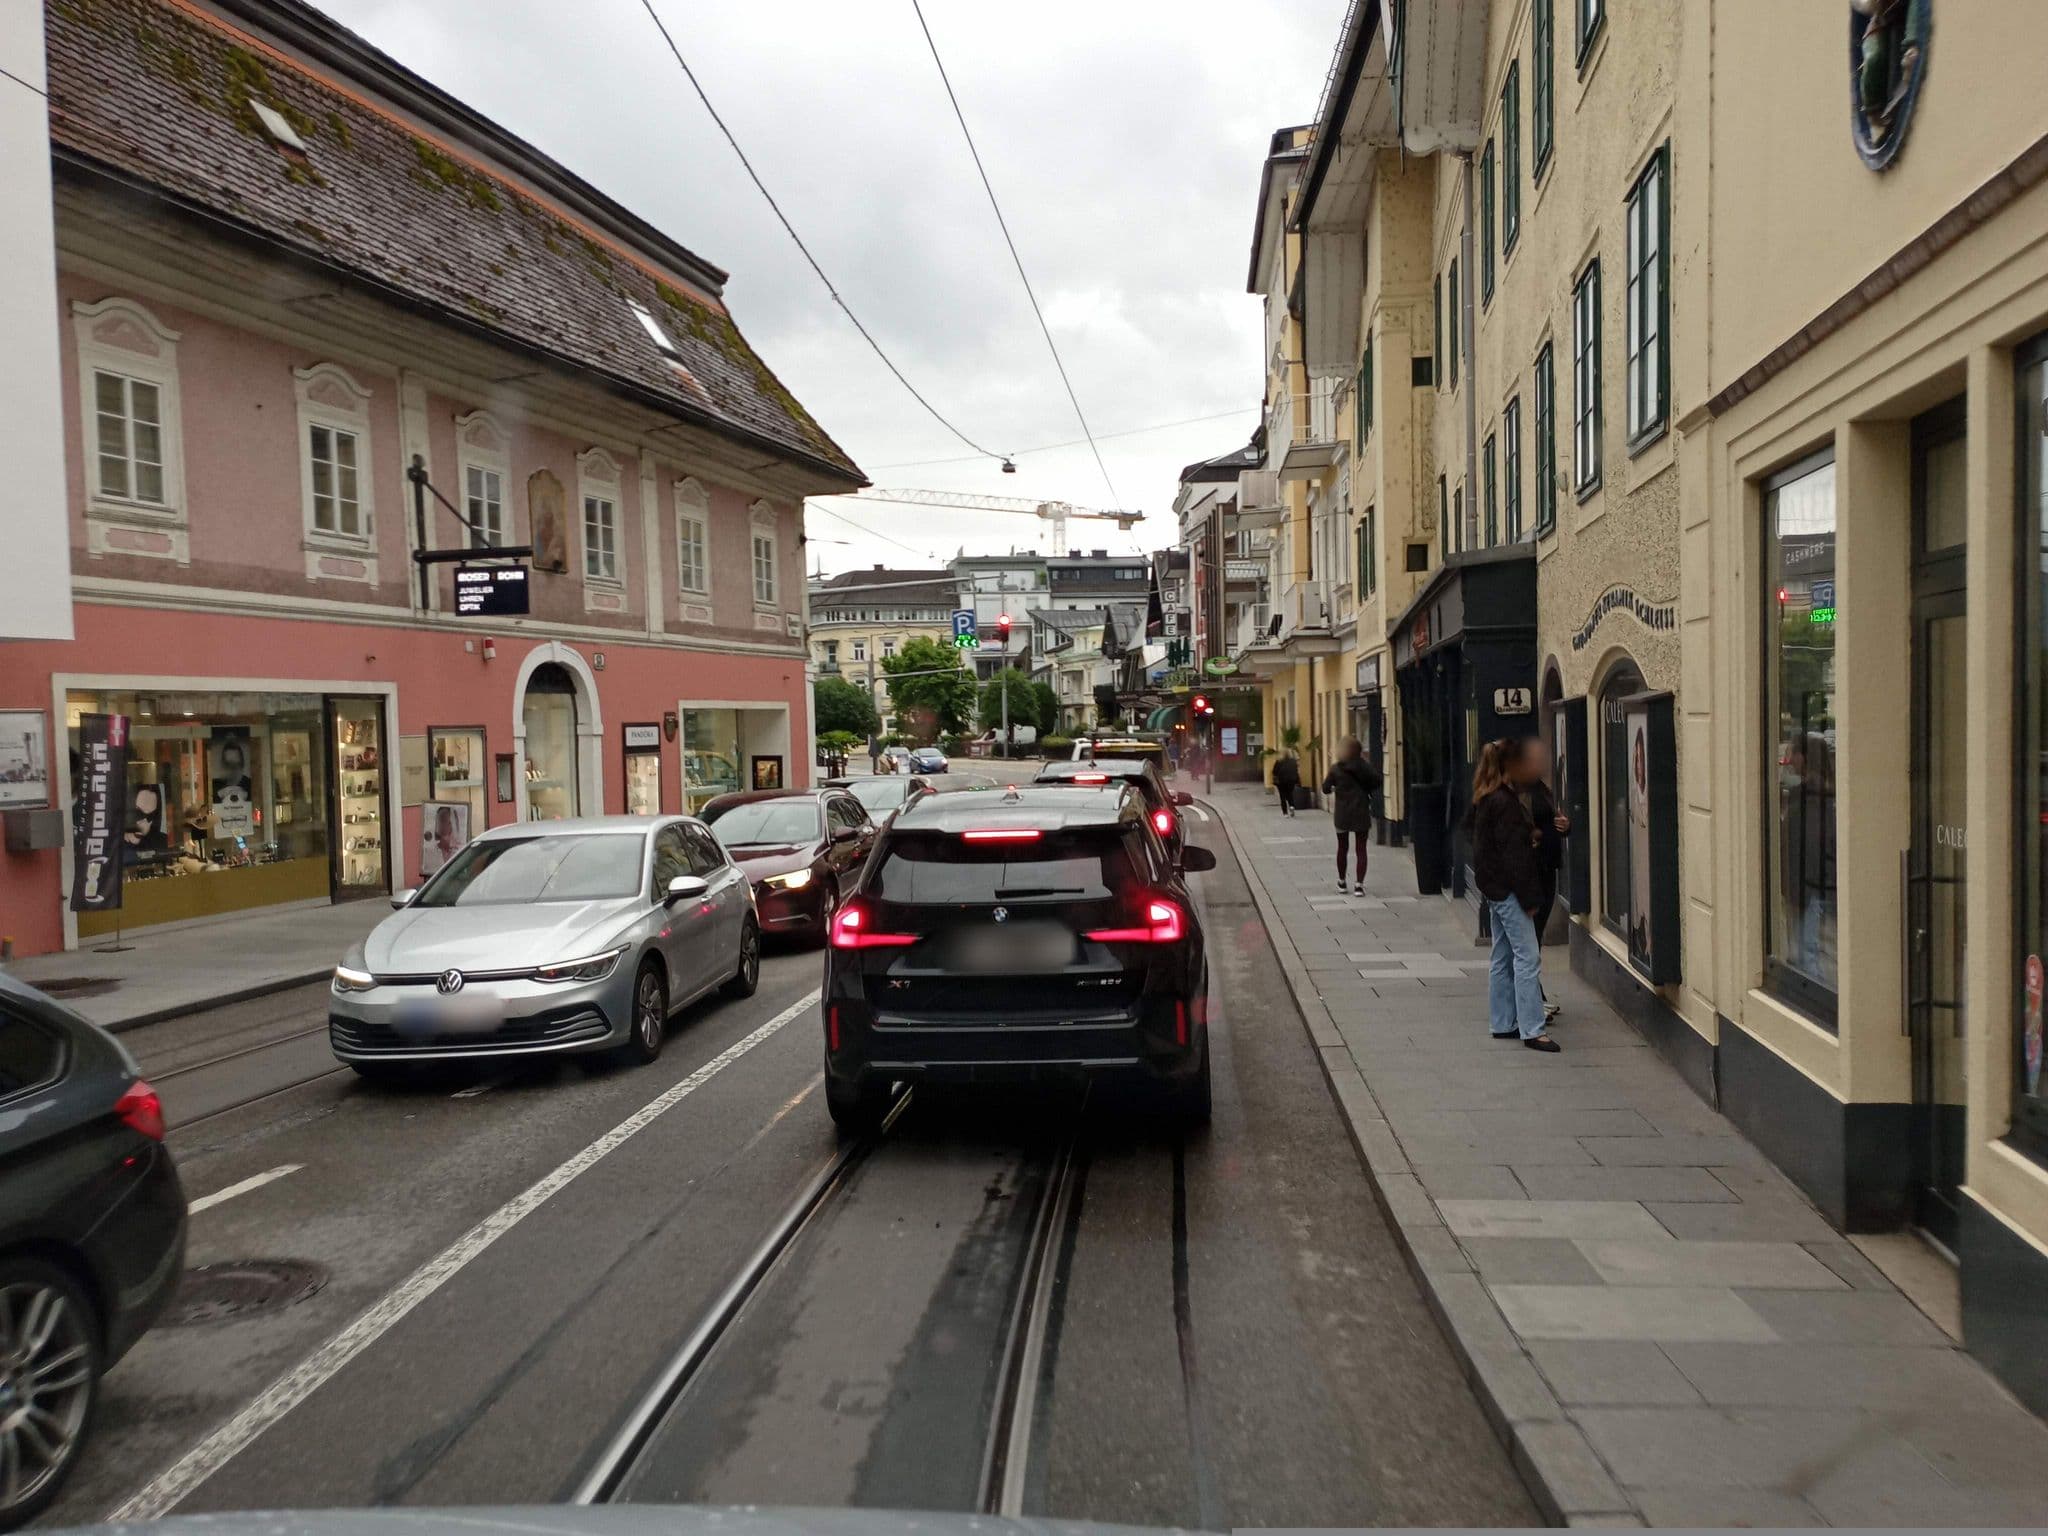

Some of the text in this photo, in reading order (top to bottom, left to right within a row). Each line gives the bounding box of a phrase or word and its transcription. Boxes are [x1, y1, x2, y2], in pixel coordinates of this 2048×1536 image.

[1785, 542, 1825, 566] CASHMERE
[957, 616, 970, 634] P
[1503, 688, 1523, 707] 14
